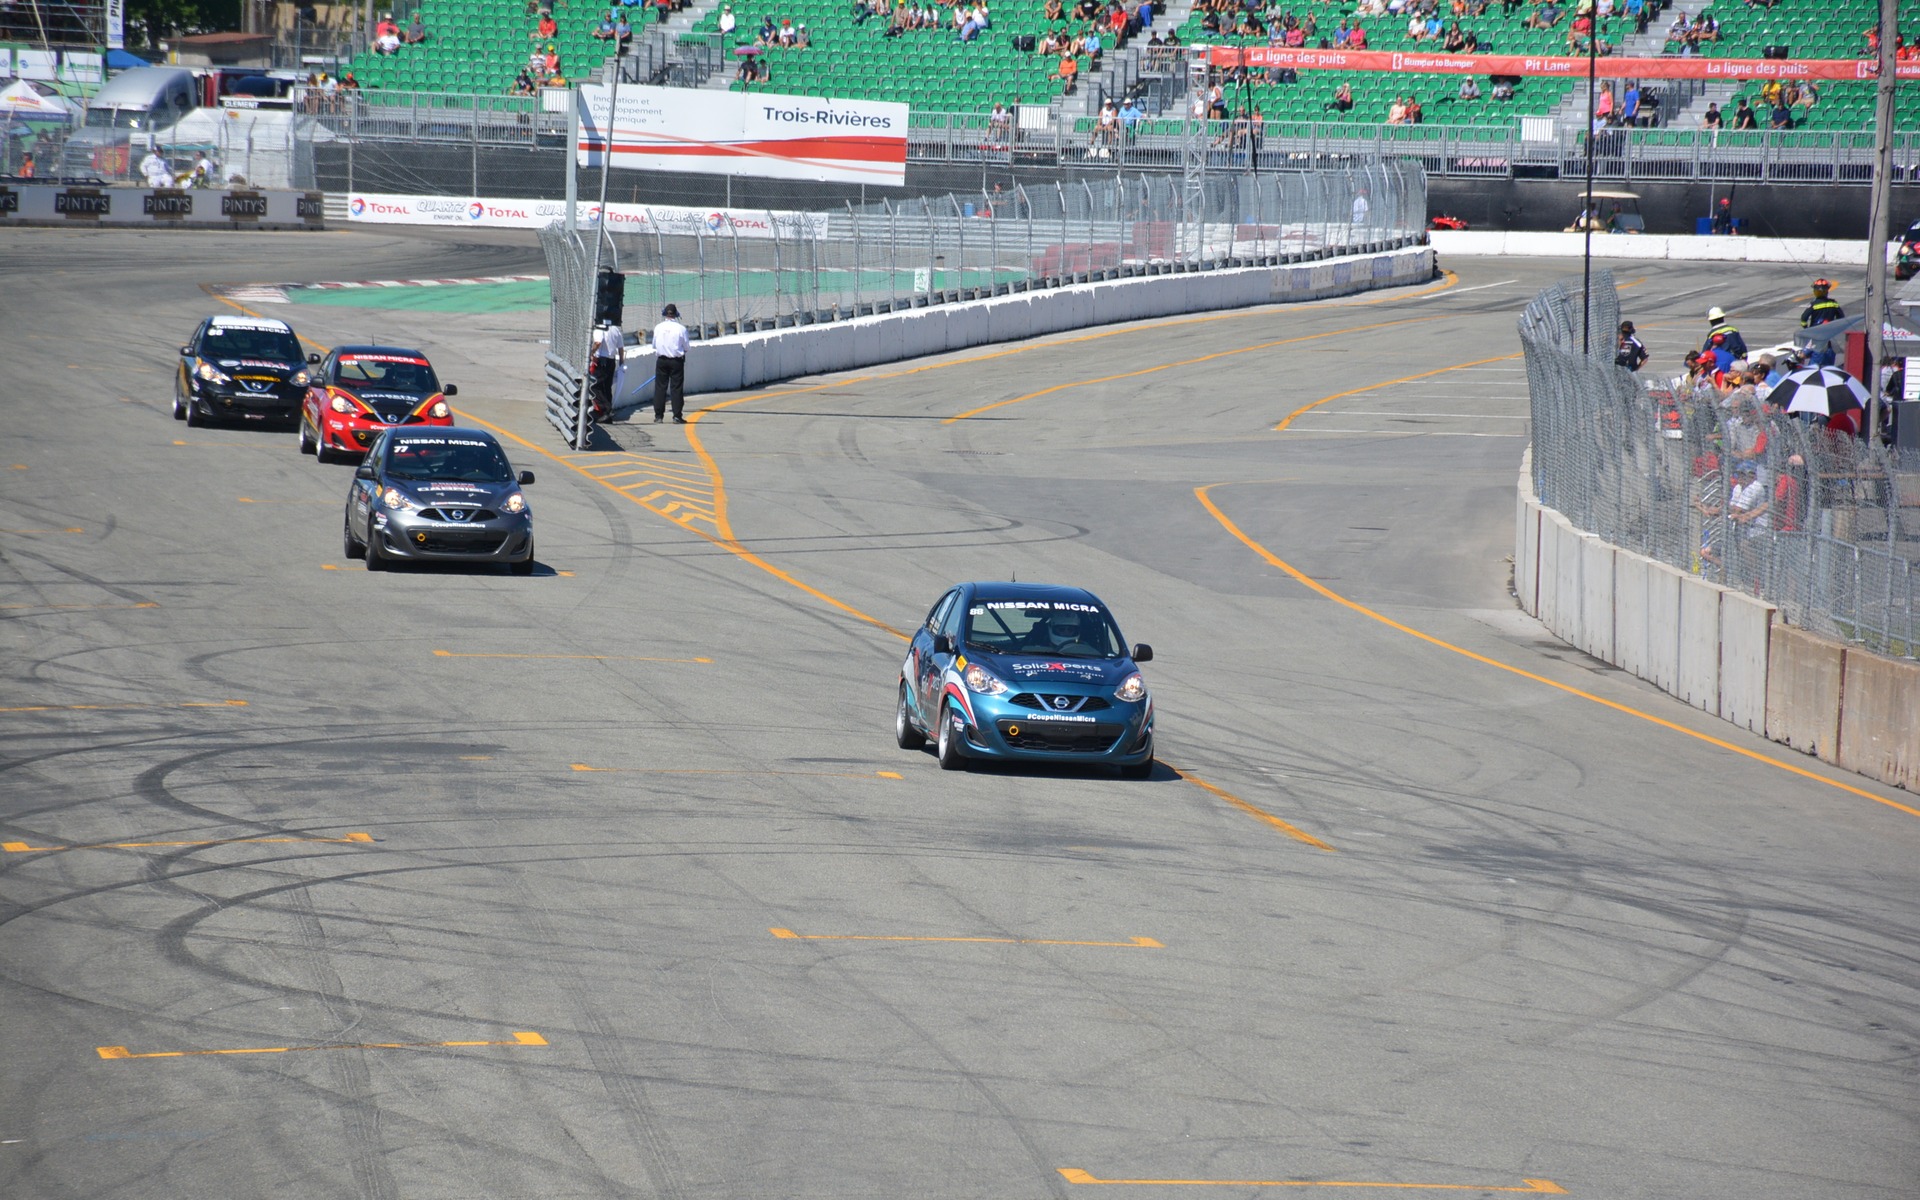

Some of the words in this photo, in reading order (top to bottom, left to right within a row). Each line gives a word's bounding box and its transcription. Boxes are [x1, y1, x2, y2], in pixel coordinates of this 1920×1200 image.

[1251, 50, 1263, 61] La
[1266, 50, 1293, 64] ligne
[1297, 51, 1315, 62] des
[1318, 53, 1346, 65] puits
[1404, 57, 1434, 67] Bumper
[1444, 59, 1474, 68] Bumper
[1525, 60, 1541, 70] Pit
[1544, 60, 1570, 71] Lane
[1707, 62, 1720, 73] La
[1724, 62, 1752, 76] ligne
[1756, 62, 1776, 74] des
[1779, 64, 1808, 76] puits
[593, 95, 638, 105] Innoation
[592, 104, 662, 116] Dévloppement
[592, 114, 647, 124] écoomique
[763, 106, 891, 129] Trois-Rivières
[57, 196, 109, 211] PINTY'S
[146, 198, 192, 212] PINTY'S
[223, 199, 266, 213] PINTY'S
[369, 202, 411, 215] TOTAL
[416, 199, 468, 213] QUARTZ
[488, 206, 529, 219] TOTAL
[606, 211, 648, 224] TOTAL
[387, 355, 416, 363] MICRA
[393, 445, 409, 453] 77
[447, 439, 487, 448] MICRA
[986, 602, 1050, 610] NISSAN
[1053, 602, 1100, 613] MICRA
[1012, 662, 1102, 672] SolidXperts
